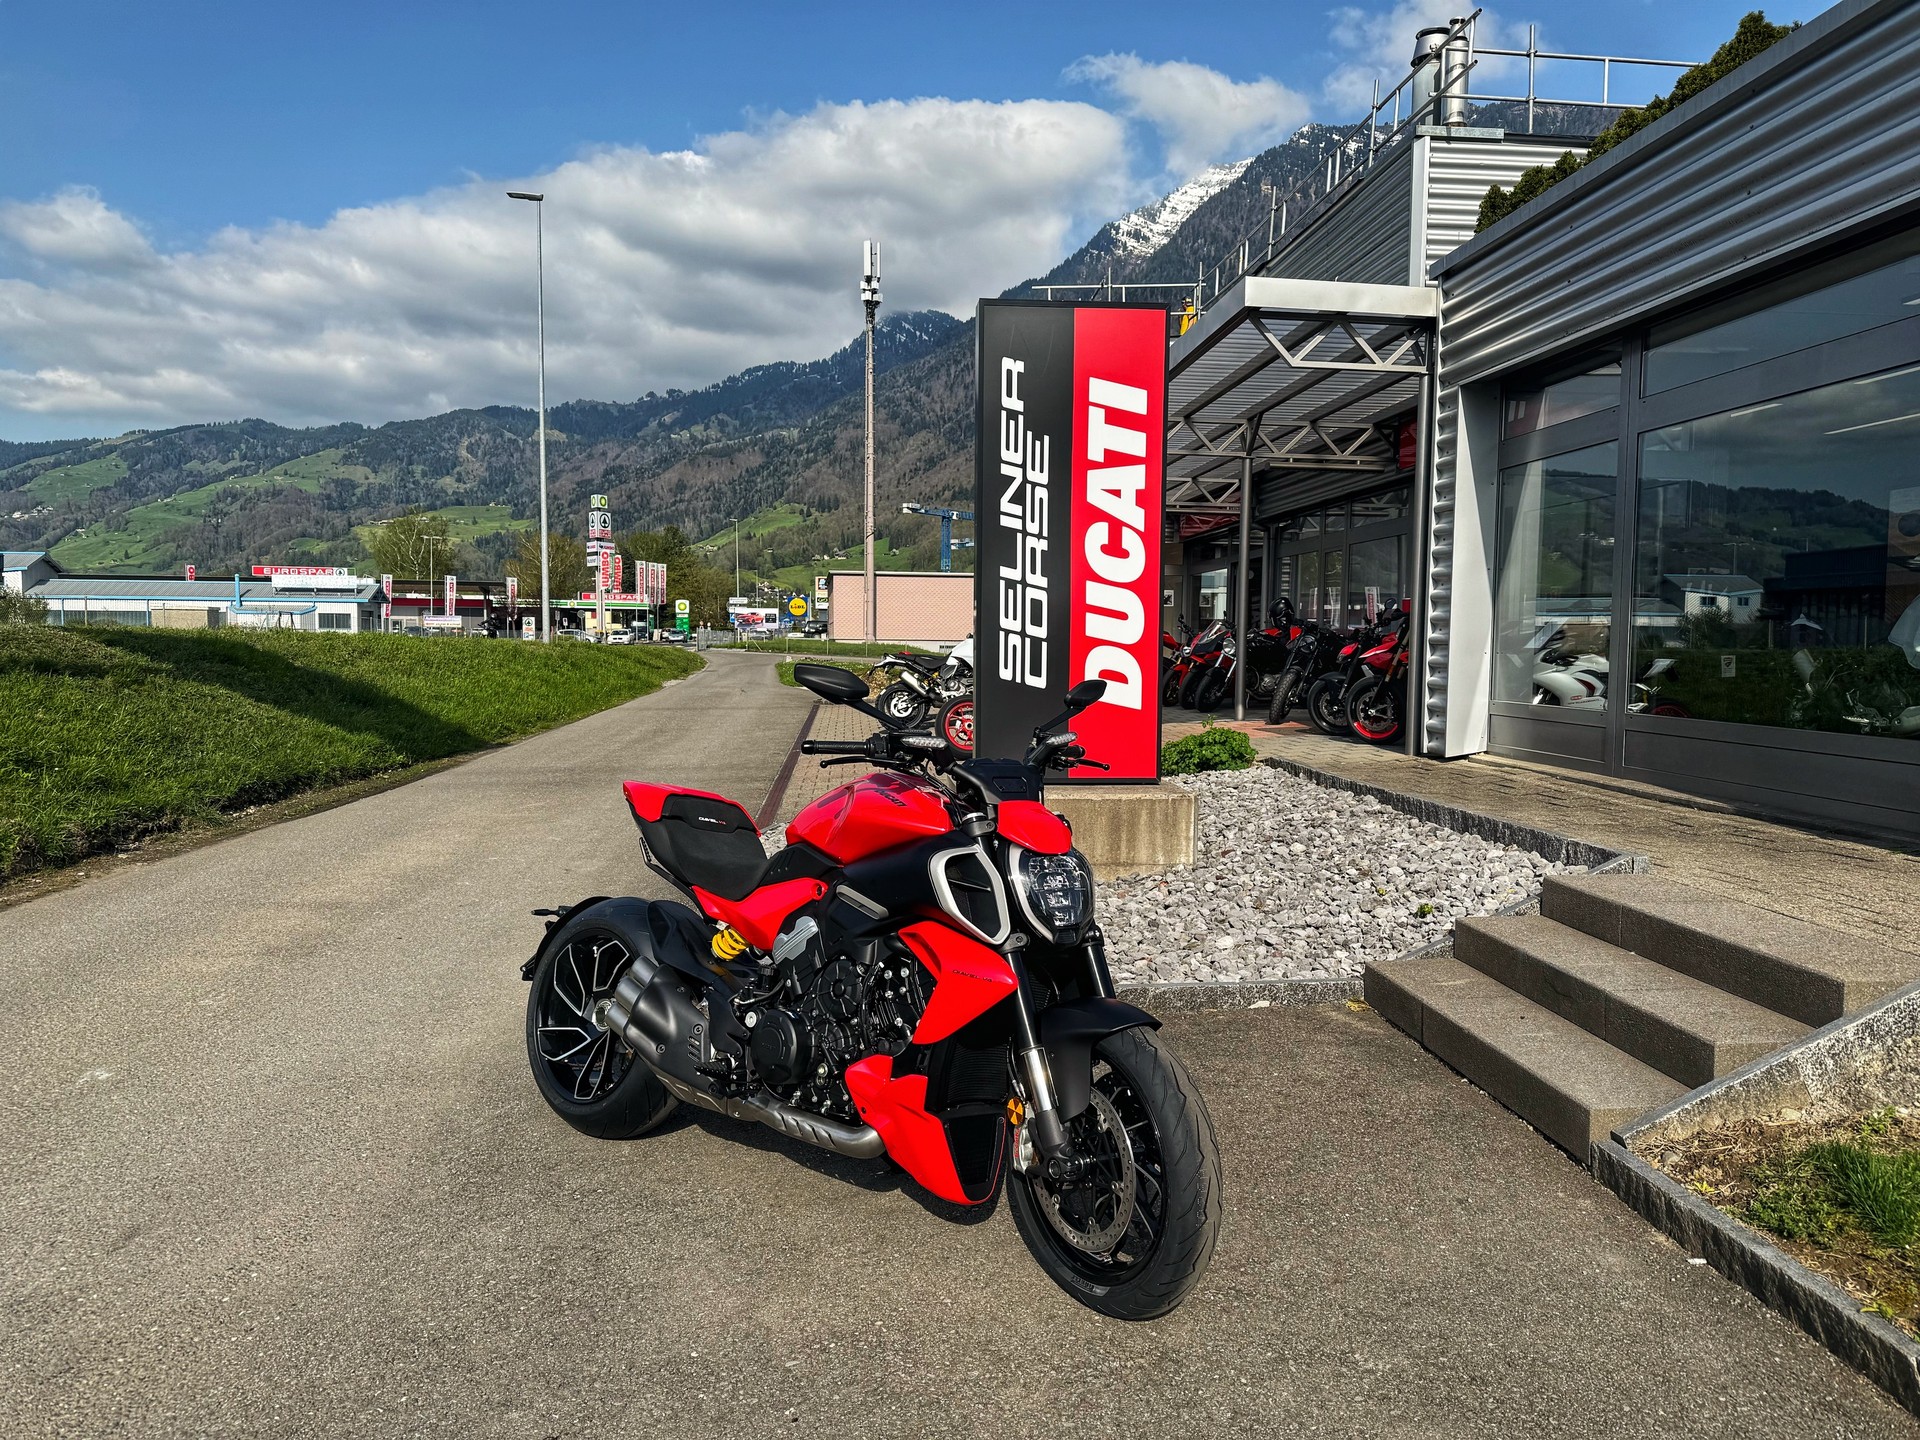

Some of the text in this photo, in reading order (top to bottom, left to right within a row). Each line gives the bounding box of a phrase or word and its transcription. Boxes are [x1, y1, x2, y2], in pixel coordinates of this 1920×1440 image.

[263, 567, 333, 576] EUROSPAR
[999, 356, 1025, 685] SELINER
[1024, 430, 1050, 690] CORSE
[1083, 376, 1148, 711] DUCATI
